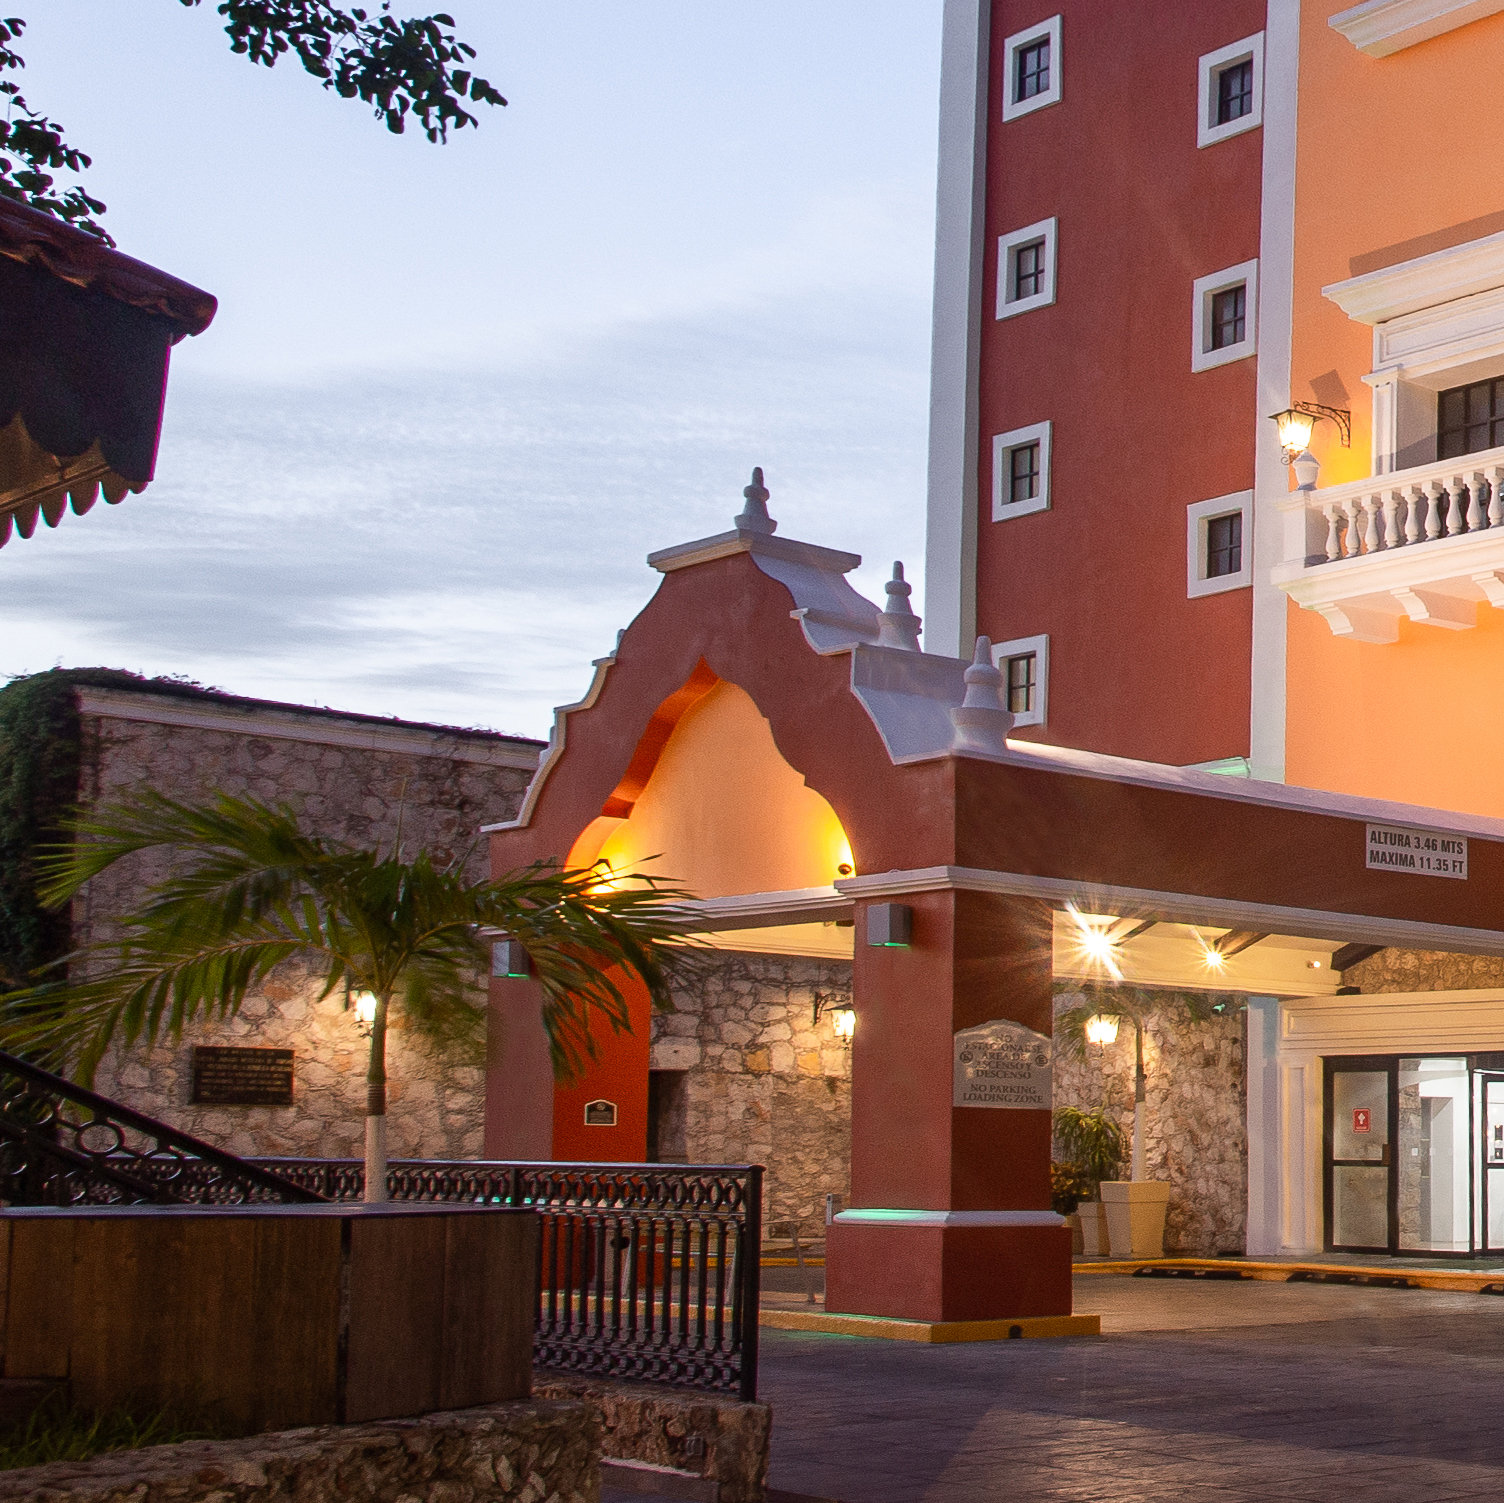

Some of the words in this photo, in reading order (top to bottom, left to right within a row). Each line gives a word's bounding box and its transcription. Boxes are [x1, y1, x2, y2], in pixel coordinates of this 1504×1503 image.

[1369, 830, 1411, 848] ALTURA
[1414, 836, 1438, 852] 3.46
[1441, 839, 1463, 854] MTS
[1369, 849, 1415, 868] MAXIMA
[1419, 856, 1449, 872] 11.35
[1452, 860, 1464, 874] FT
[963, 1041, 1043, 1054] ESTACONARSE
[976, 1069, 1032, 1079] DESCENSO
[970, 1083, 987, 1093] NO
[989, 1085, 1036, 1094] PARKING
[963, 1092, 1013, 1103] LOADING
[1014, 1094, 1044, 1104] ZONE
